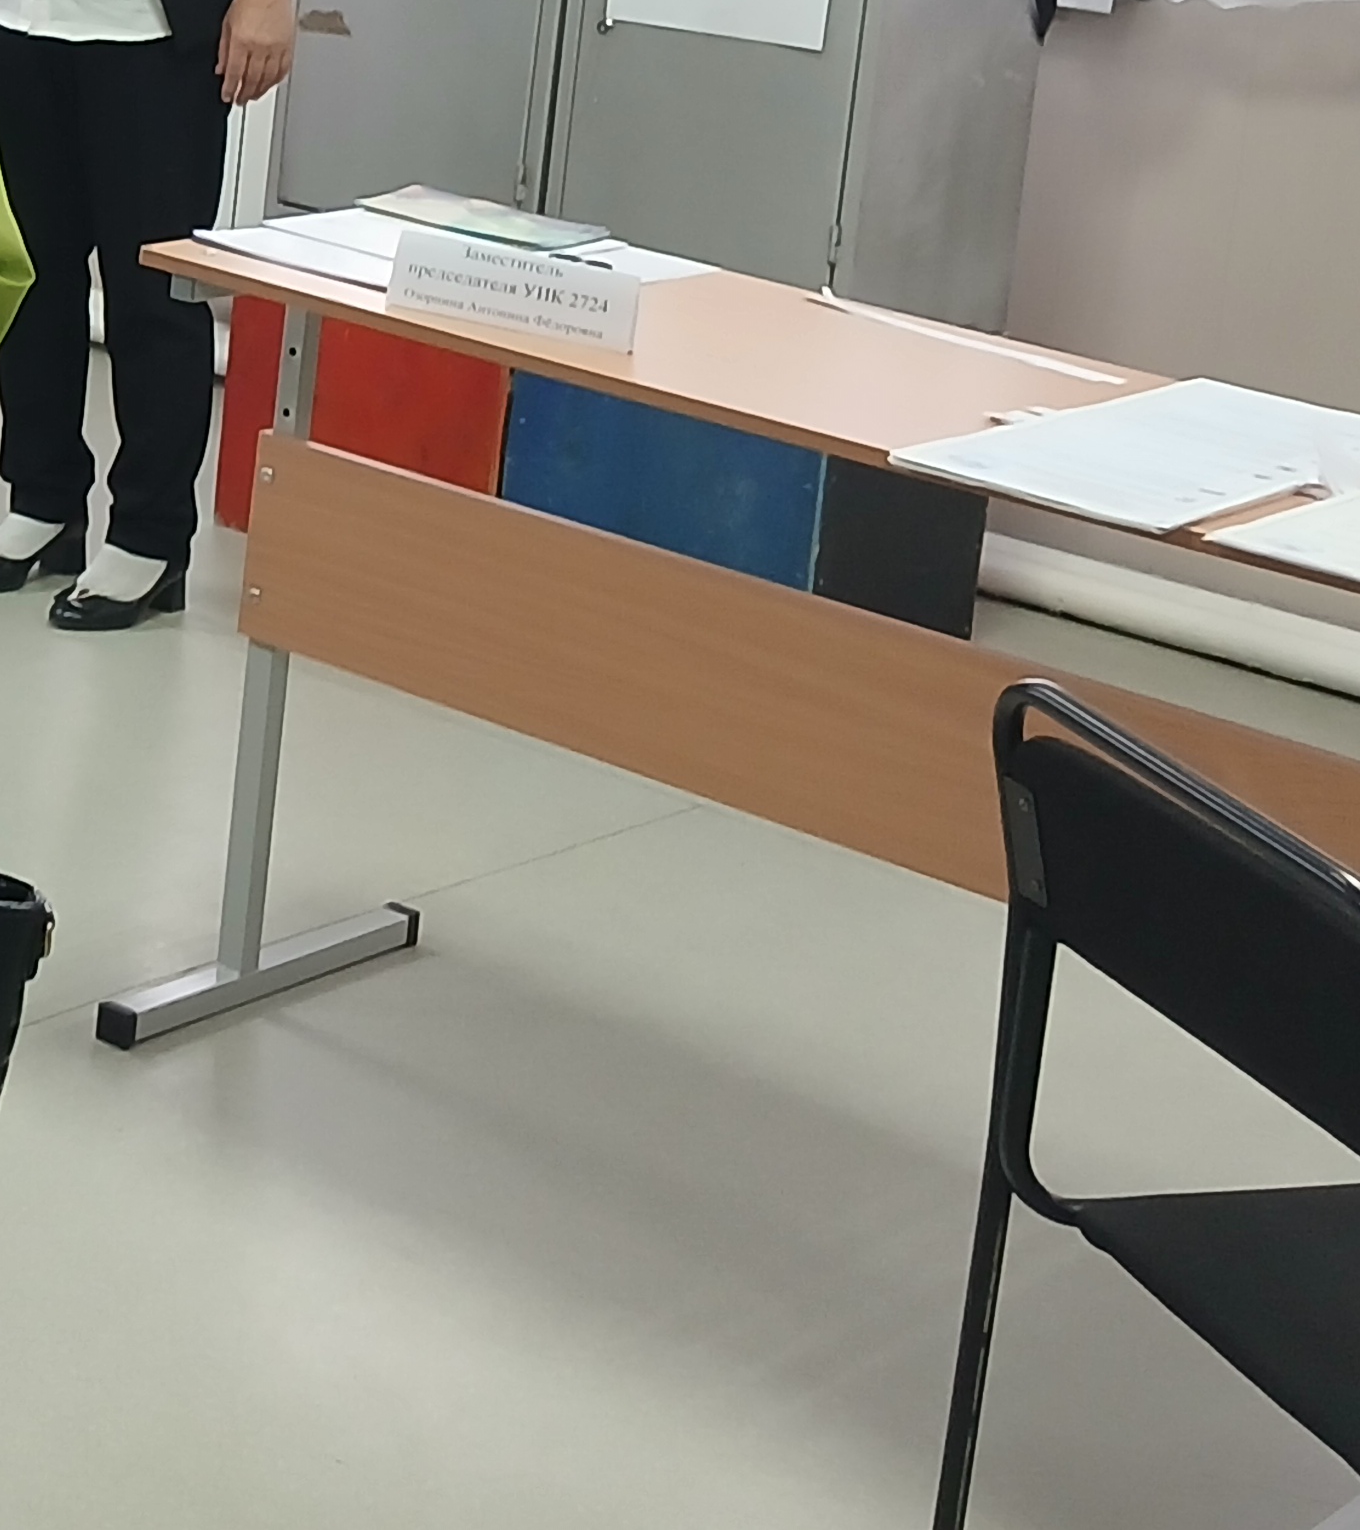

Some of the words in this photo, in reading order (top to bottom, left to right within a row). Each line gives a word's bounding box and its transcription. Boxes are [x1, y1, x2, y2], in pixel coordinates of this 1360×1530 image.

[464, 245, 564, 278] Заместитель
[408, 263, 518, 296] председателя
[523, 282, 565, 305] УИК
[568, 292, 609, 314] 2724
